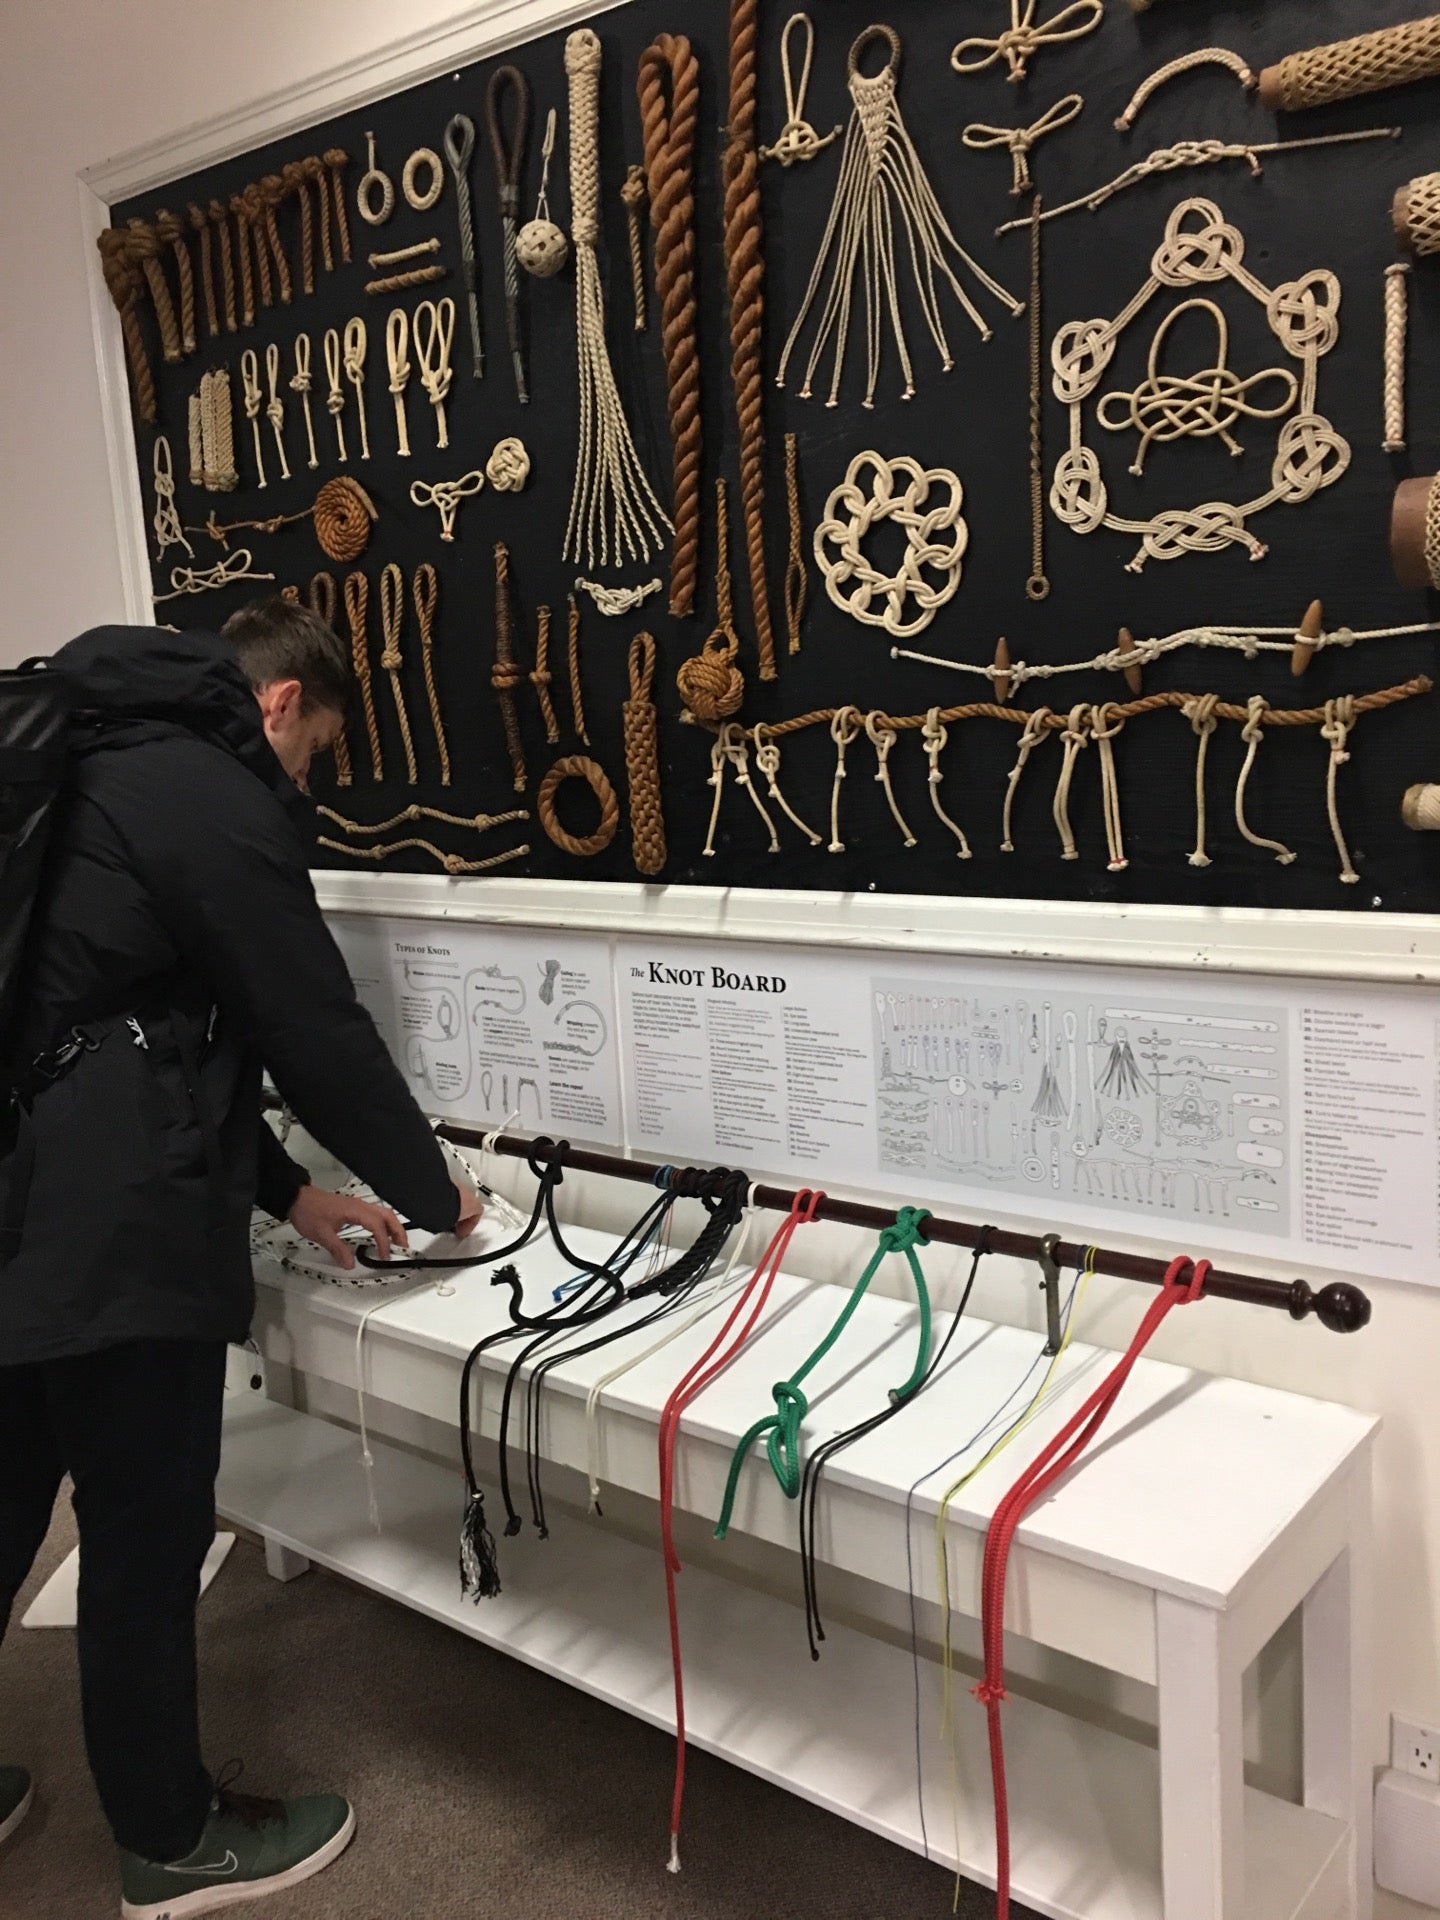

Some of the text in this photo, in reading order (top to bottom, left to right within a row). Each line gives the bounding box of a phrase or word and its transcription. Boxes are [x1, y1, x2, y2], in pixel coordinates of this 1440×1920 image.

[395, 943, 451, 956] TYPES OF KNOTS
[630, 961, 787, 993] The KNOT BOARD
